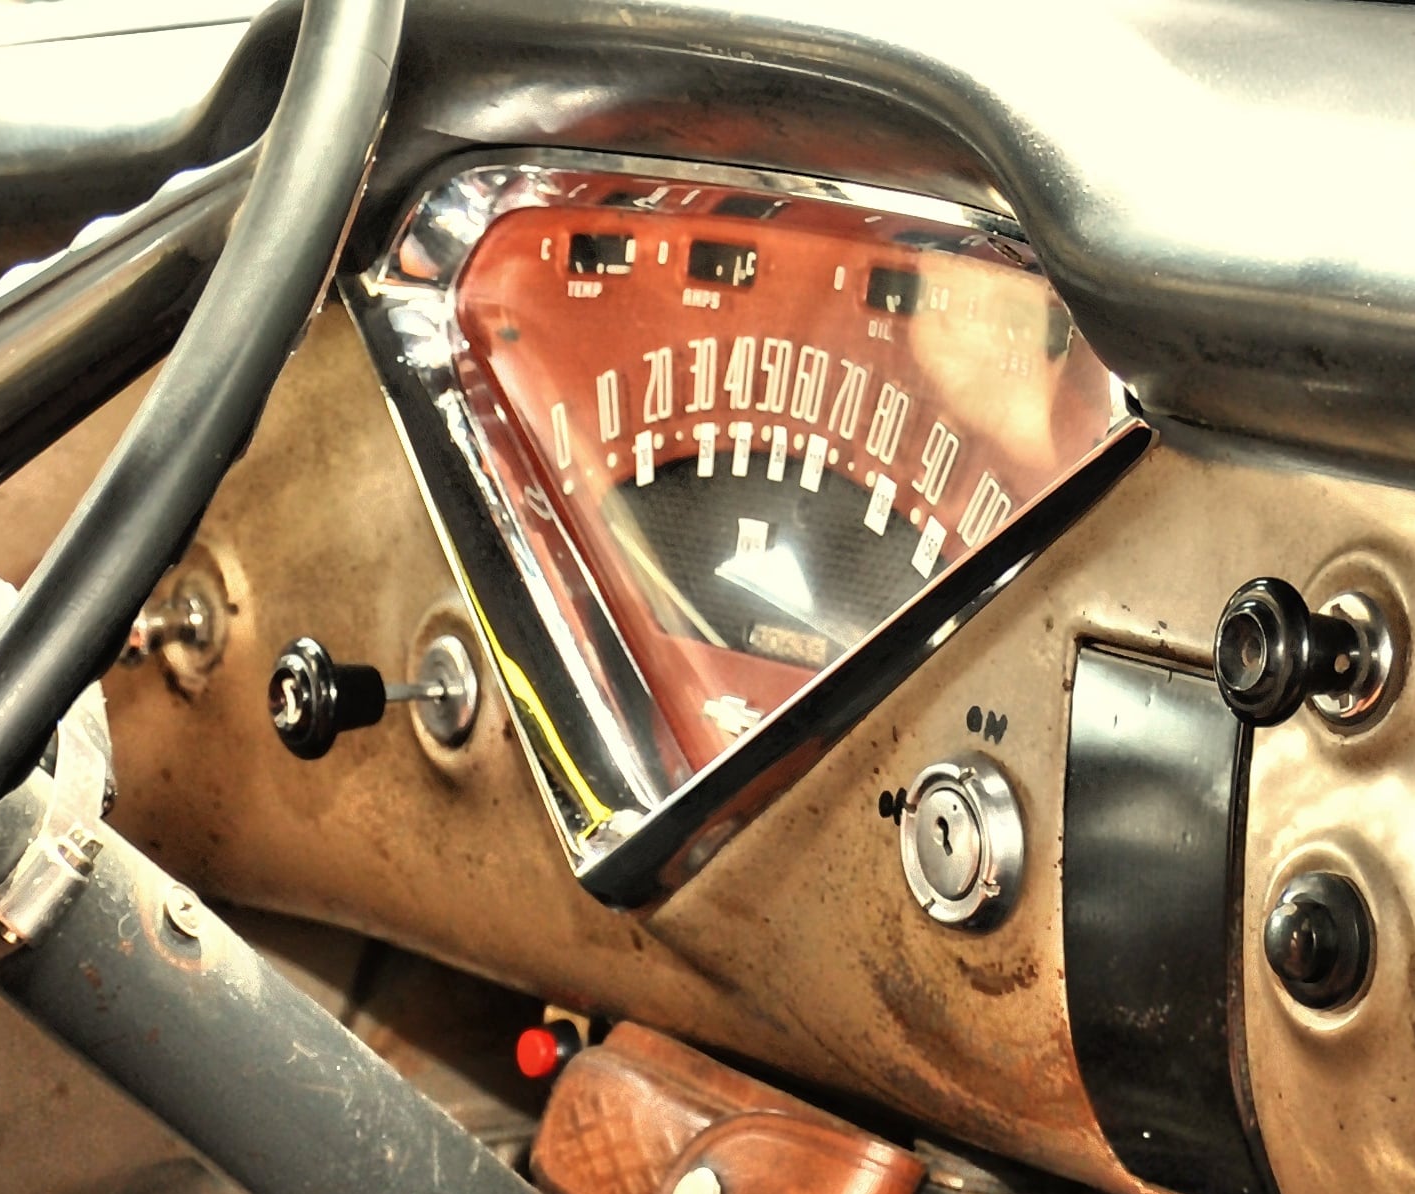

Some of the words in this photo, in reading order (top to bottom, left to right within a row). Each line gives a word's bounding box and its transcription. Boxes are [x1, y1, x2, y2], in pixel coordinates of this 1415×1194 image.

[567, 280, 603, 298] TEMP
[682, 287, 721, 310] AMPS
[930, 286, 950, 311] 60
[867, 319, 892, 341] OIL
[551, 402, 572, 470] 0
[596, 369, 620, 443] 10
[643, 346, 672, 424] 20
[685, 337, 717, 413] 30
[723, 336, 756, 410] 40
[756, 337, 793, 414] 50
[790, 345, 829, 424] 60
[828, 358, 867, 440] 70
[866, 382, 909, 466] 80
[911, 421, 959, 506] 90
[957, 471, 1012, 548] 100
[966, 705, 1008, 745] ON
